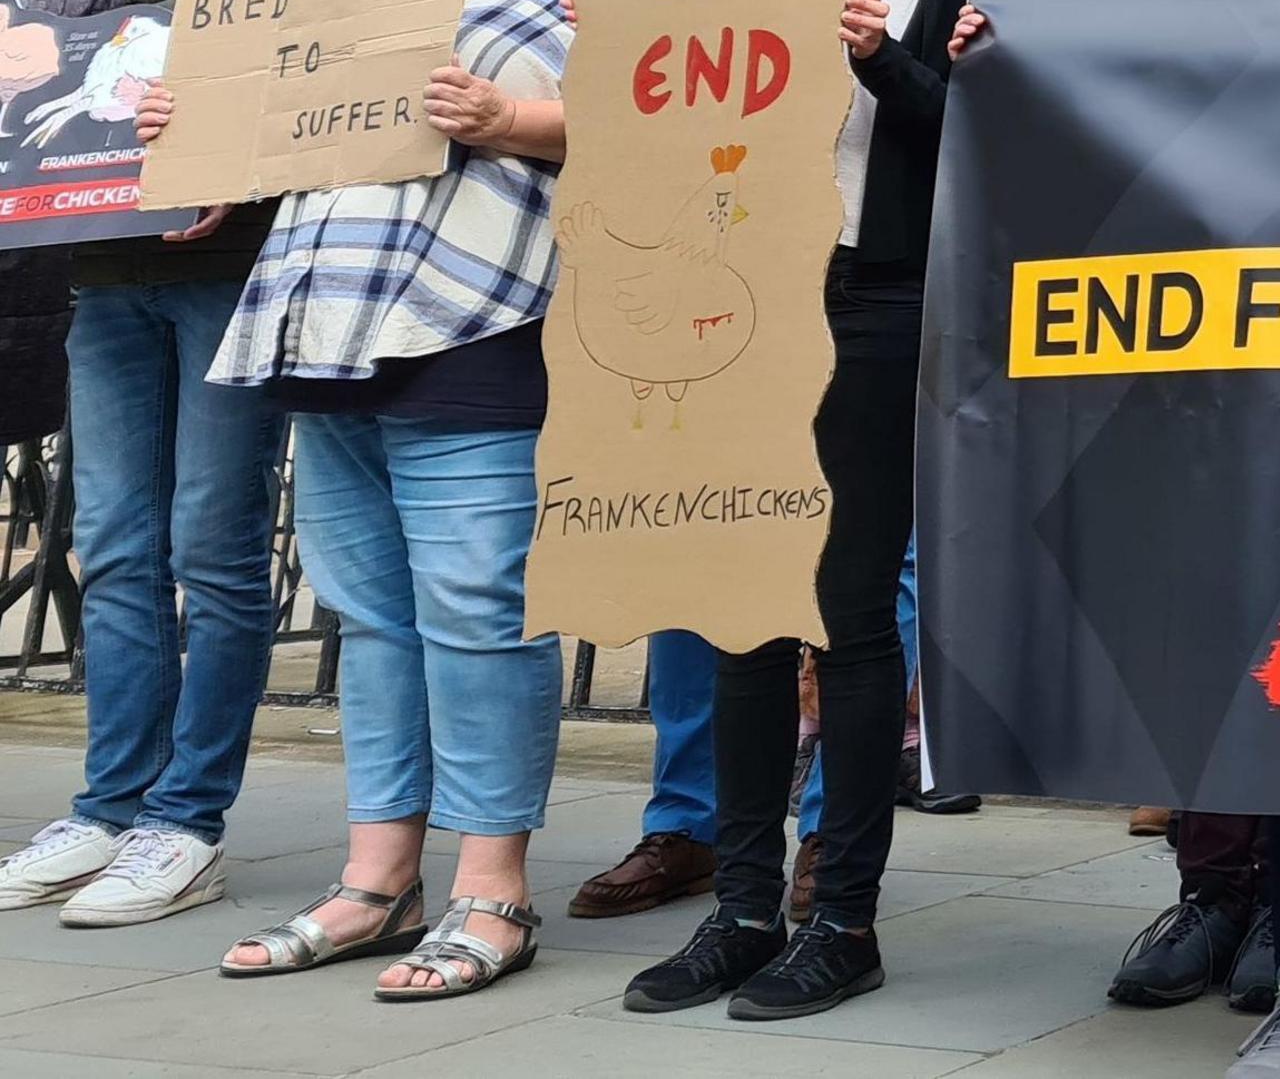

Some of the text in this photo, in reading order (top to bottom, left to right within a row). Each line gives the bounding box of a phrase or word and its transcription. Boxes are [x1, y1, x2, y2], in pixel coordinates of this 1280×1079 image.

[276, 41, 321, 79] TO
[632, 26, 791, 119] END
[1033, 271, 1202, 357] END
[536, 476, 829, 540] FRANKENCHICKENS
